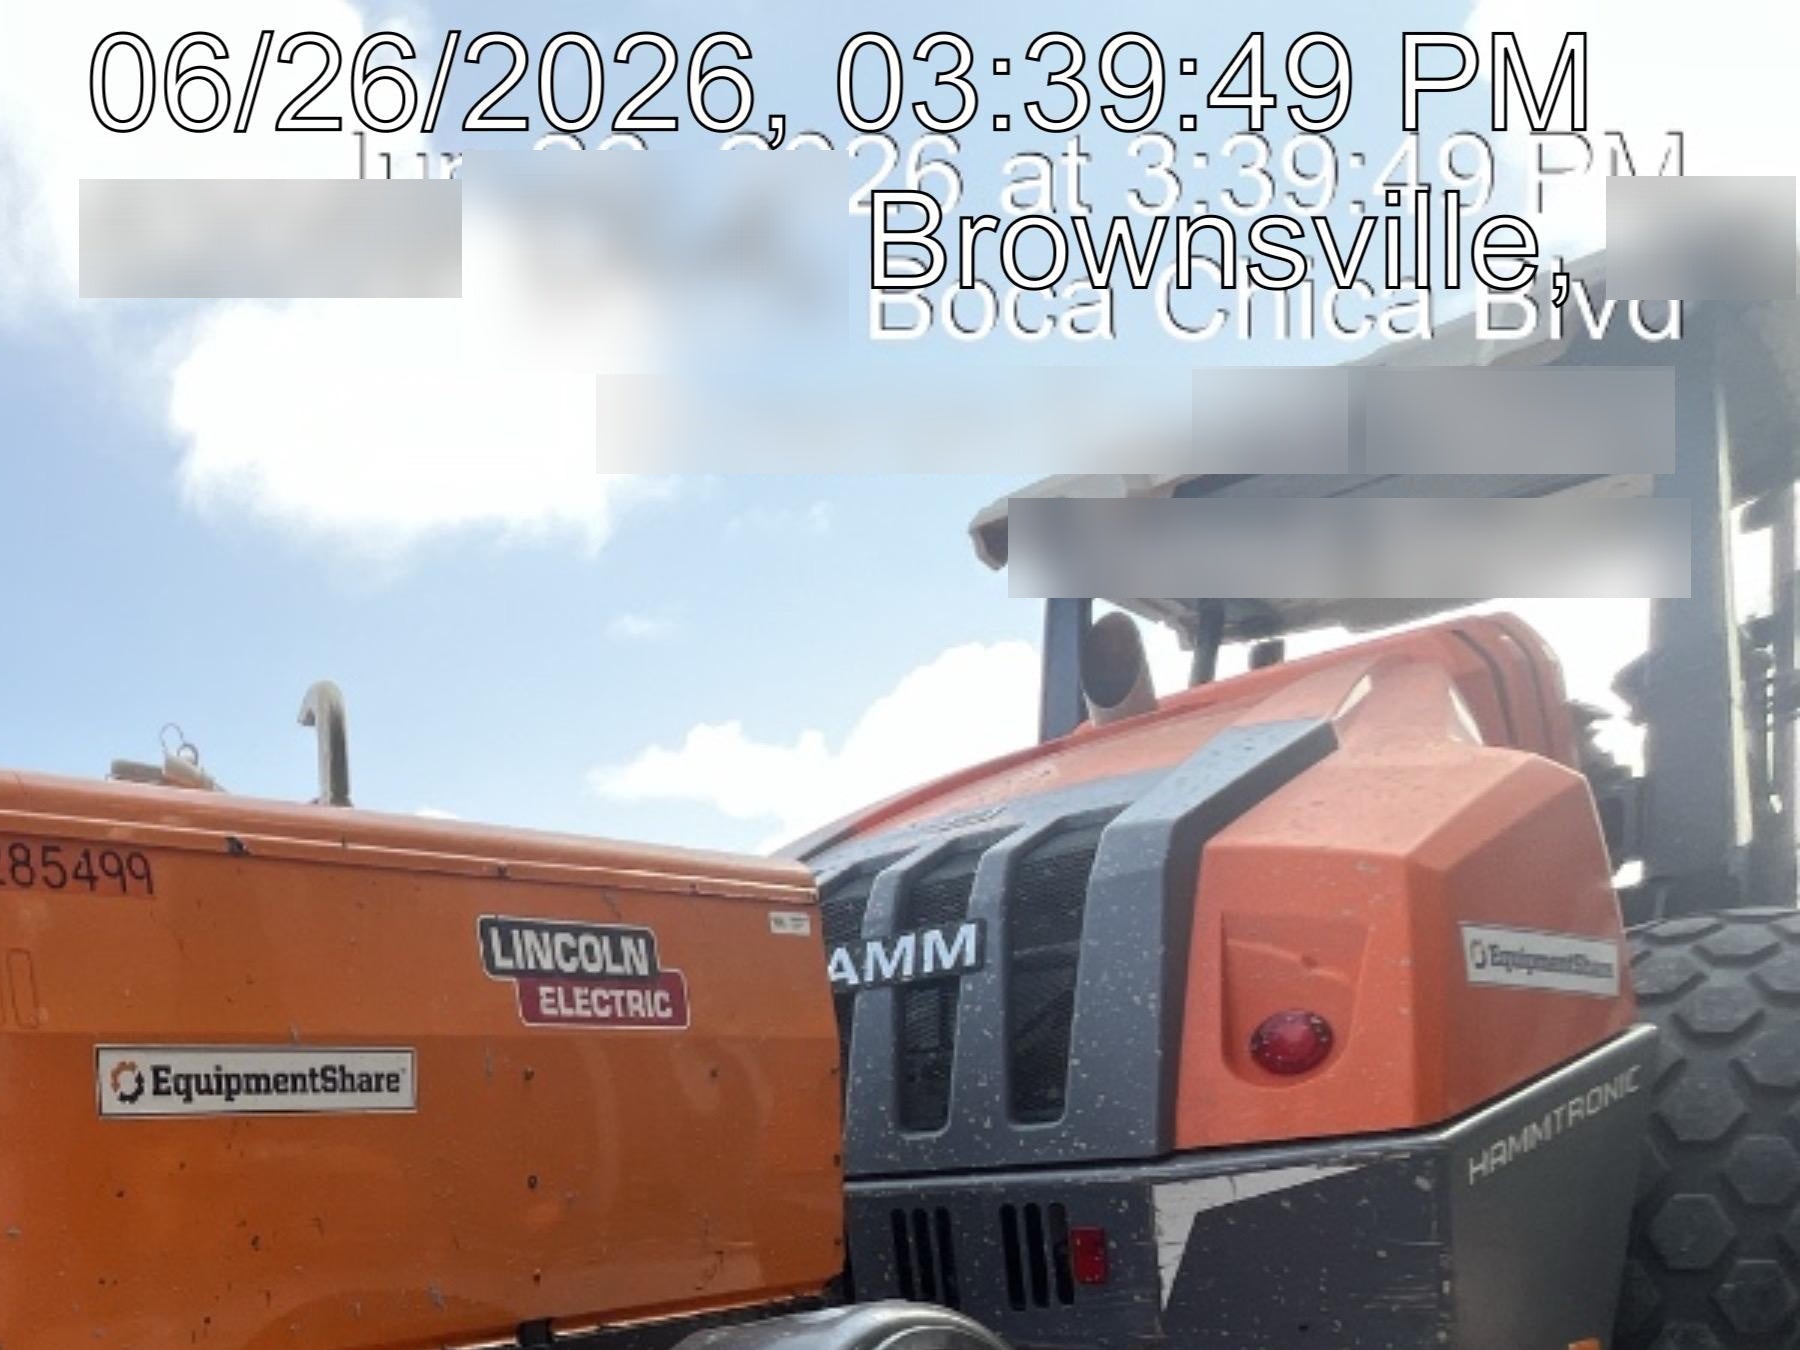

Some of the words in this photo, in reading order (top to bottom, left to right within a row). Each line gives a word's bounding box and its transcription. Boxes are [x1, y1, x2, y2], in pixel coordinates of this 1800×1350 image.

[490, 926, 650, 976] LINCOLN
[828, 922, 977, 985] AMM
[538, 985, 673, 1018] ELECTRIC
[150, 1065, 401, 1103] EquipmentShare
[1468, 1064, 1642, 1186] HAMMTRONIC
